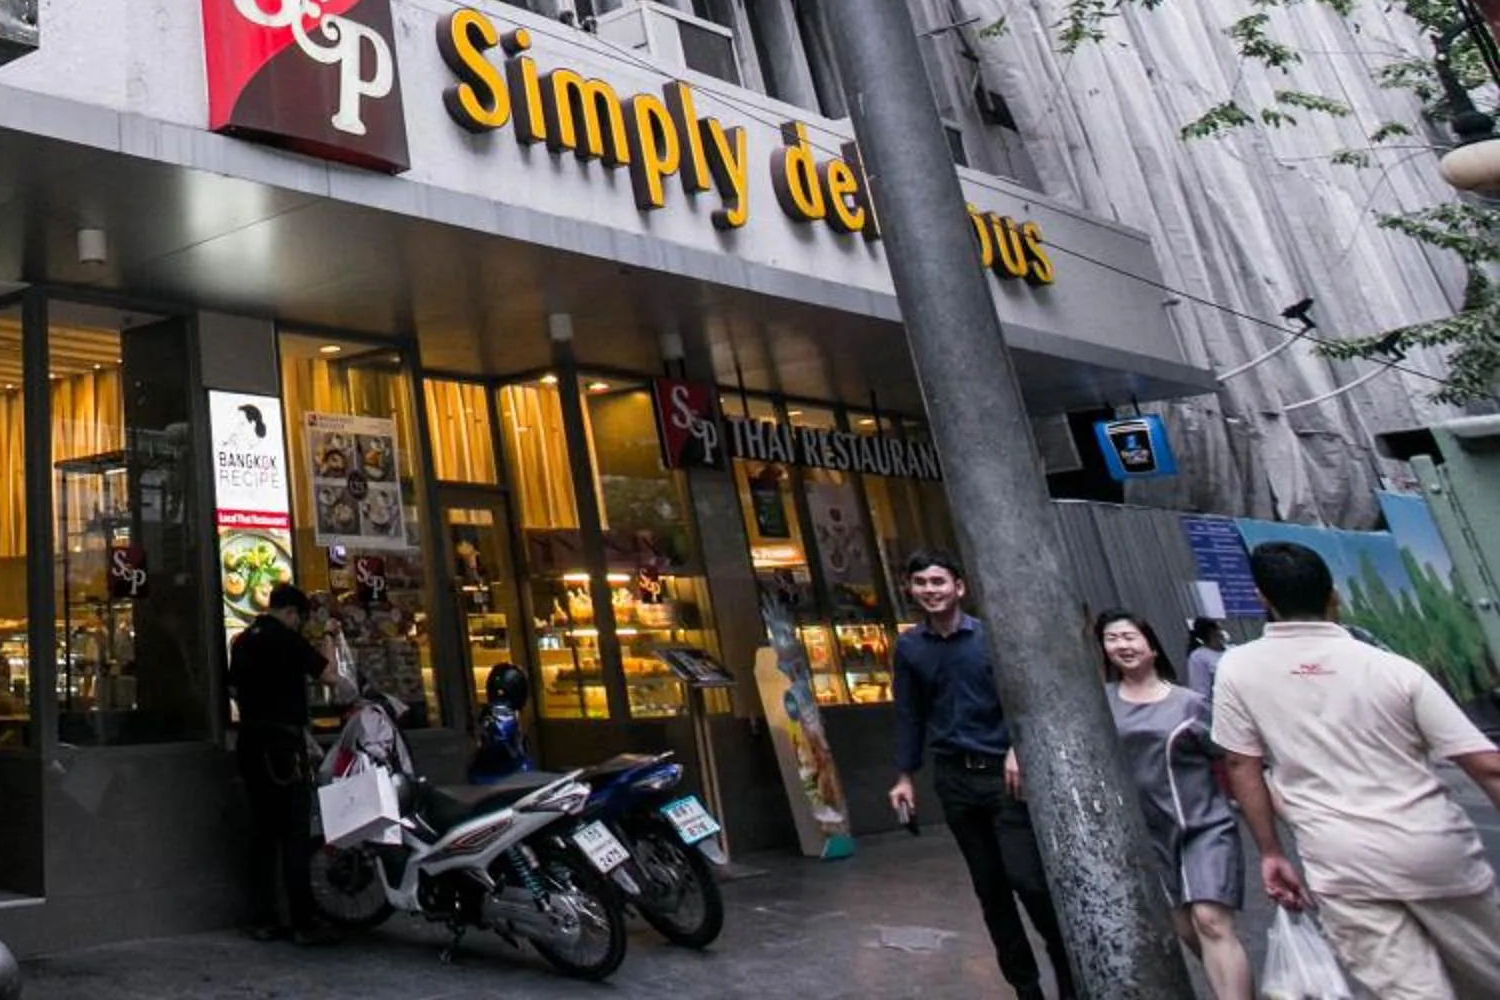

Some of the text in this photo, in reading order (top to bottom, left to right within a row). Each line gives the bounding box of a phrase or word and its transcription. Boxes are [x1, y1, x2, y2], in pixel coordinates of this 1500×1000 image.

[438, 7, 747, 231] Simply
[219, 451, 276, 470] BANGKOK
[731, 418, 794, 463] THAI
[803, 430, 939, 479] RESTAURAN
[220, 470, 280, 489] RECIPE
